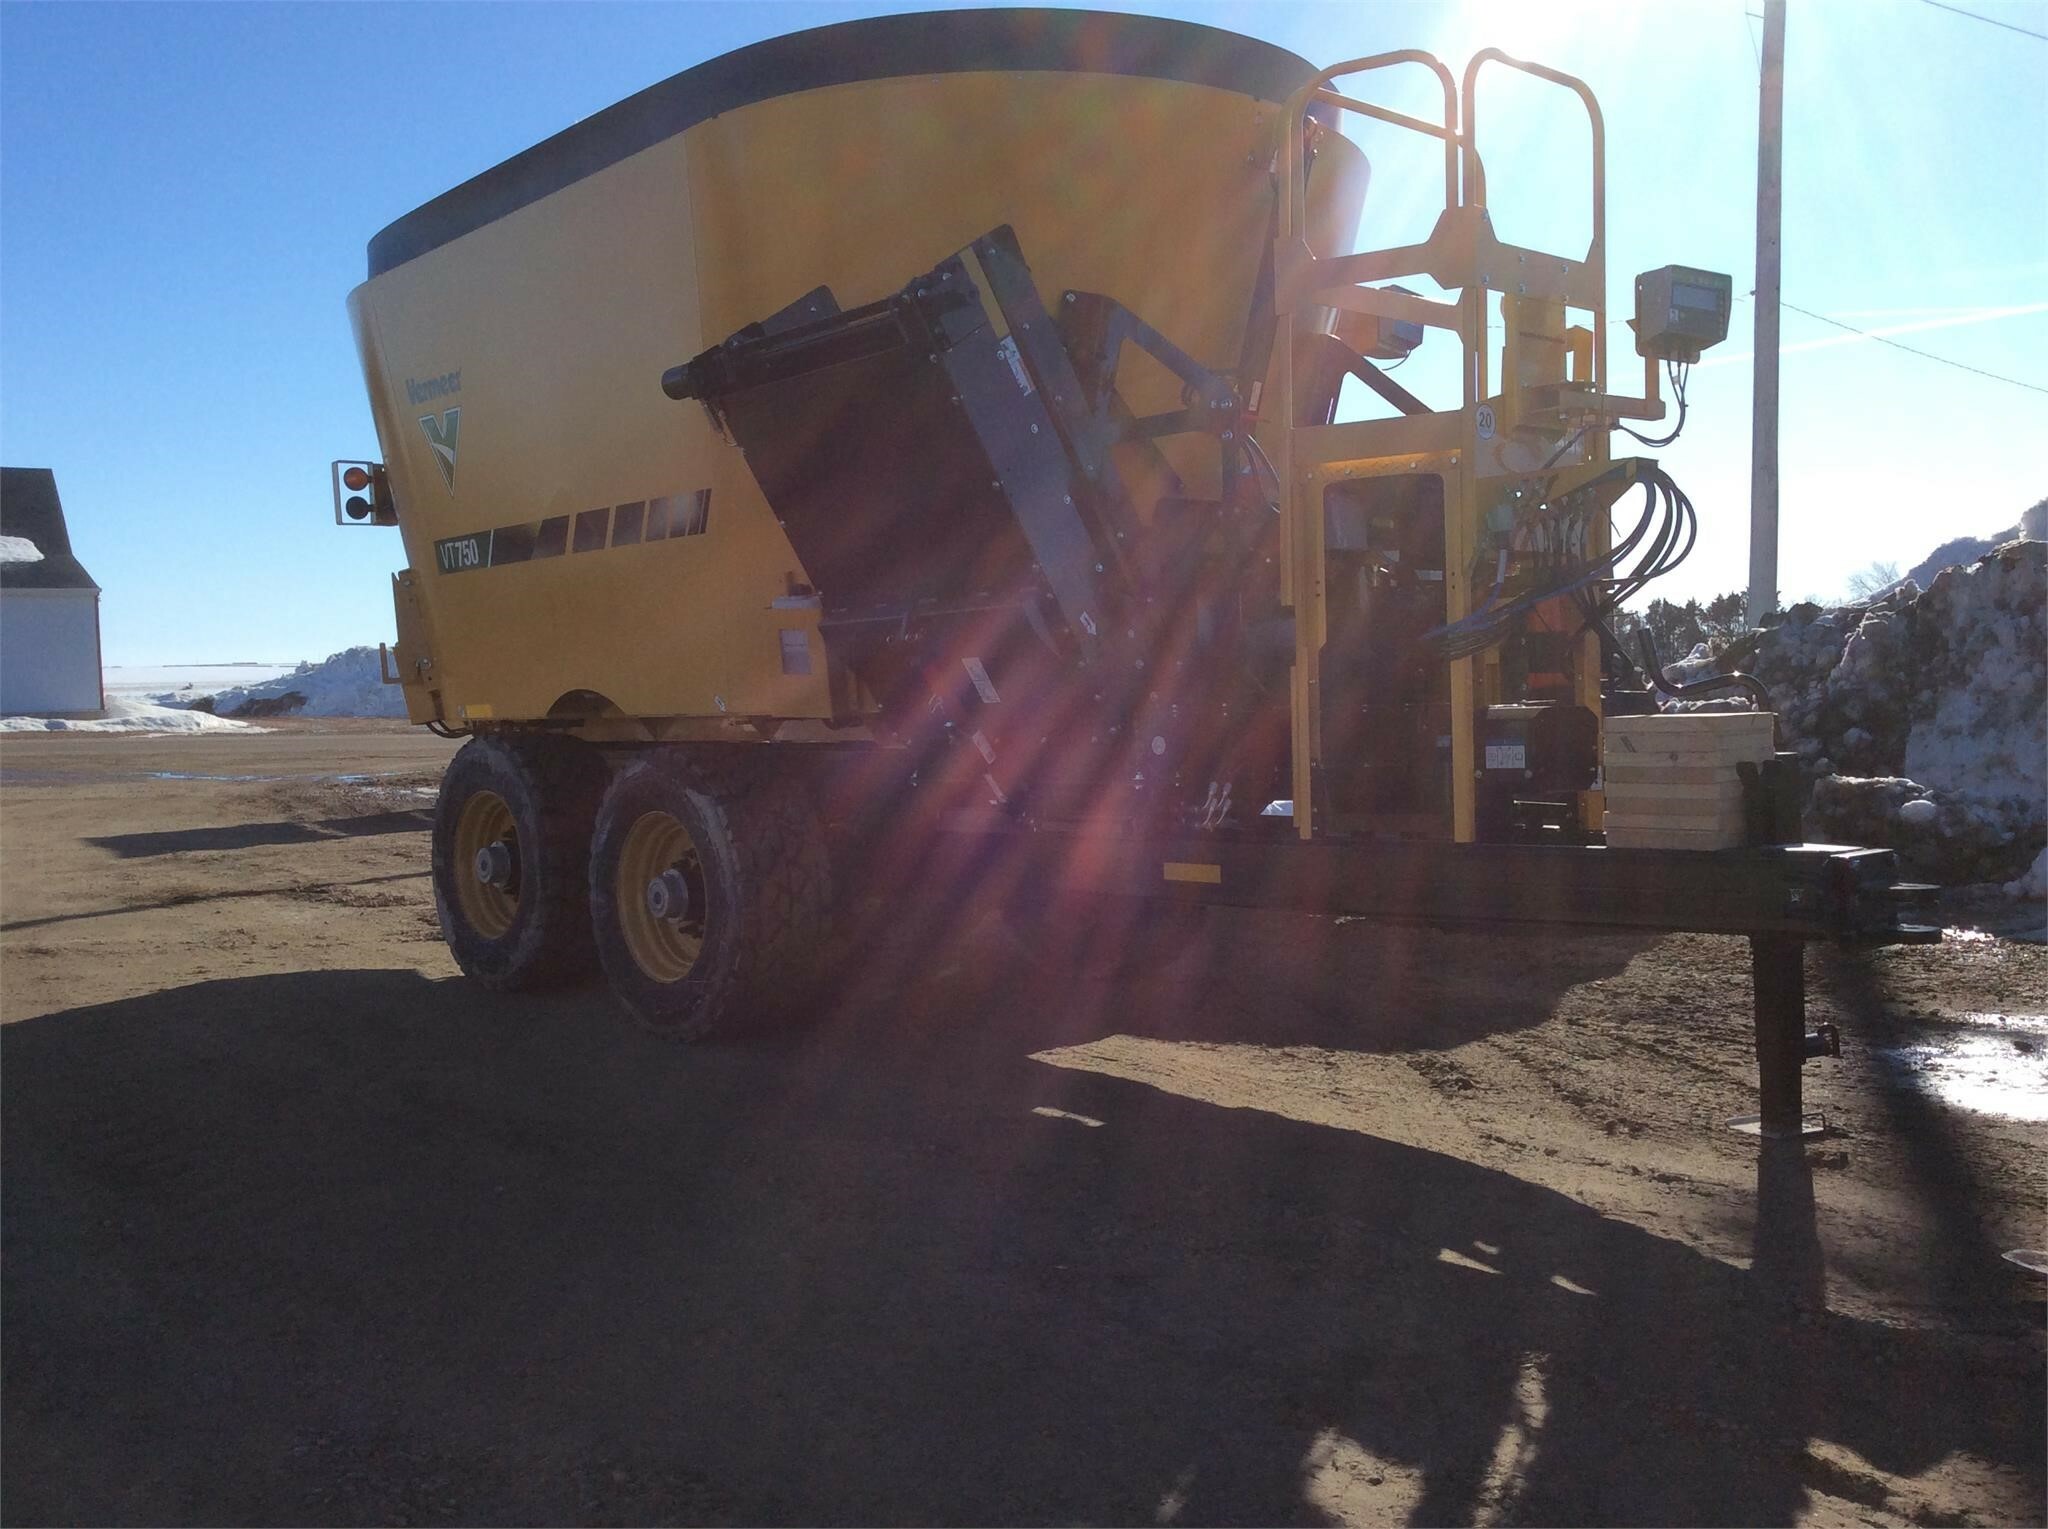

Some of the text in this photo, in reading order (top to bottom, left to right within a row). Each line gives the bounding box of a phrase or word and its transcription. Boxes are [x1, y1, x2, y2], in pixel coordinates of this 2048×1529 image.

[406, 369, 461, 405] Vermeer
[1479, 411, 1492, 428] 20
[439, 538, 480, 569] VT750
